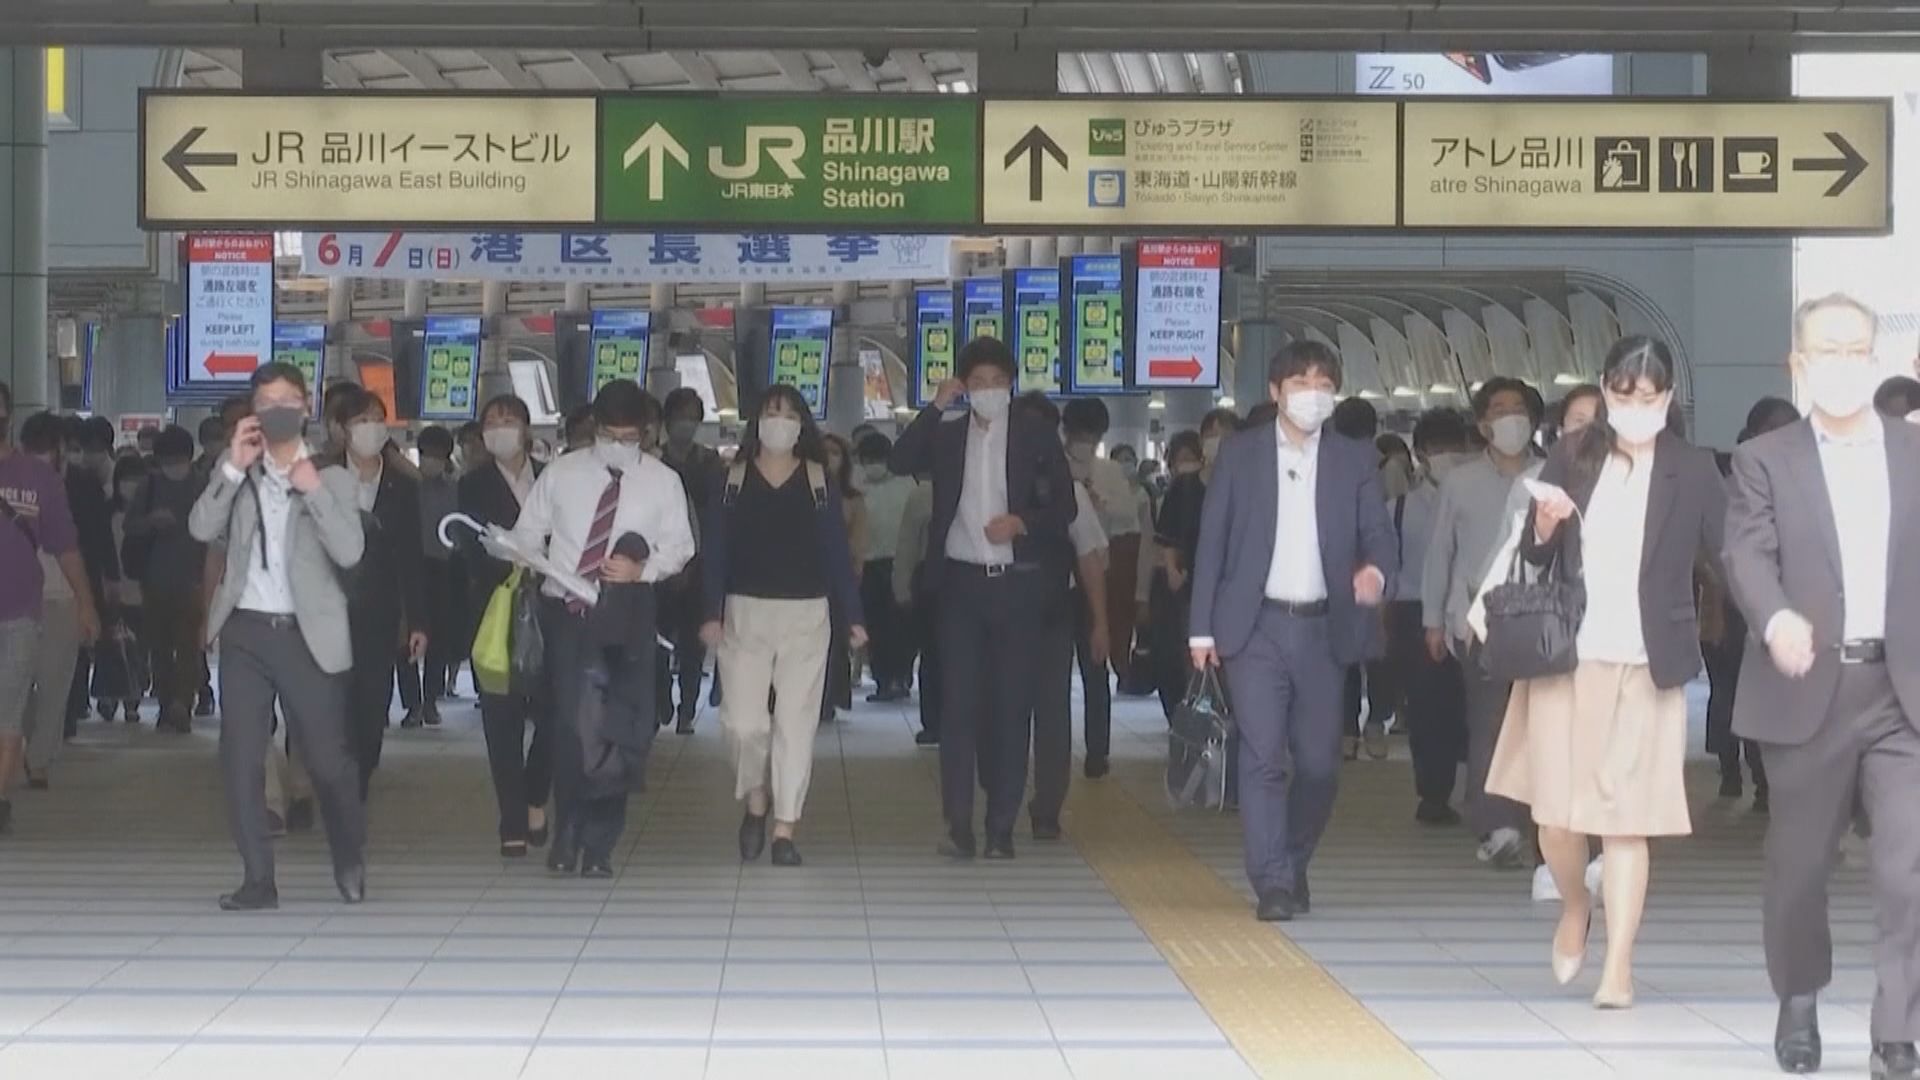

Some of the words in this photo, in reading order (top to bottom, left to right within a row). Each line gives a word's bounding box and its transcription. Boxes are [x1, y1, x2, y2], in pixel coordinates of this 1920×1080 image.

[1402, 73, 1425, 90] 50
[823, 117, 936, 154] 品川駅
[1134, 118, 1233, 137] びゅうプラザ
[252, 131, 305, 164] JR
[321, 132, 570, 164] 品川イーストビル
[708, 125, 807, 179] JR
[1431, 137, 1584, 169] アトレ品川
[251, 171, 277, 189] JR
[284, 170, 392, 193] Shinagawa
[400, 171, 443, 189] East
[449, 170, 527, 193] Building
[823, 162, 949, 186] Shinagawa
[721, 182, 795, 199] JR東日本
[1430, 178, 1467, 194] atre
[1473, 175, 1582, 198] Shinagawa
[823, 187, 905, 208] Station
[214, 251, 247, 260] NOTICE
[1163, 257, 1195, 266] NOTICE
[217, 312, 243, 321] Please
[1164, 318, 1190, 326] Please
[205, 324, 230, 335] KEEP
[232, 324, 255, 335] LEFT
[1150, 330, 1174, 340] KEEP
[1176, 330, 1205, 340] RIGHT
